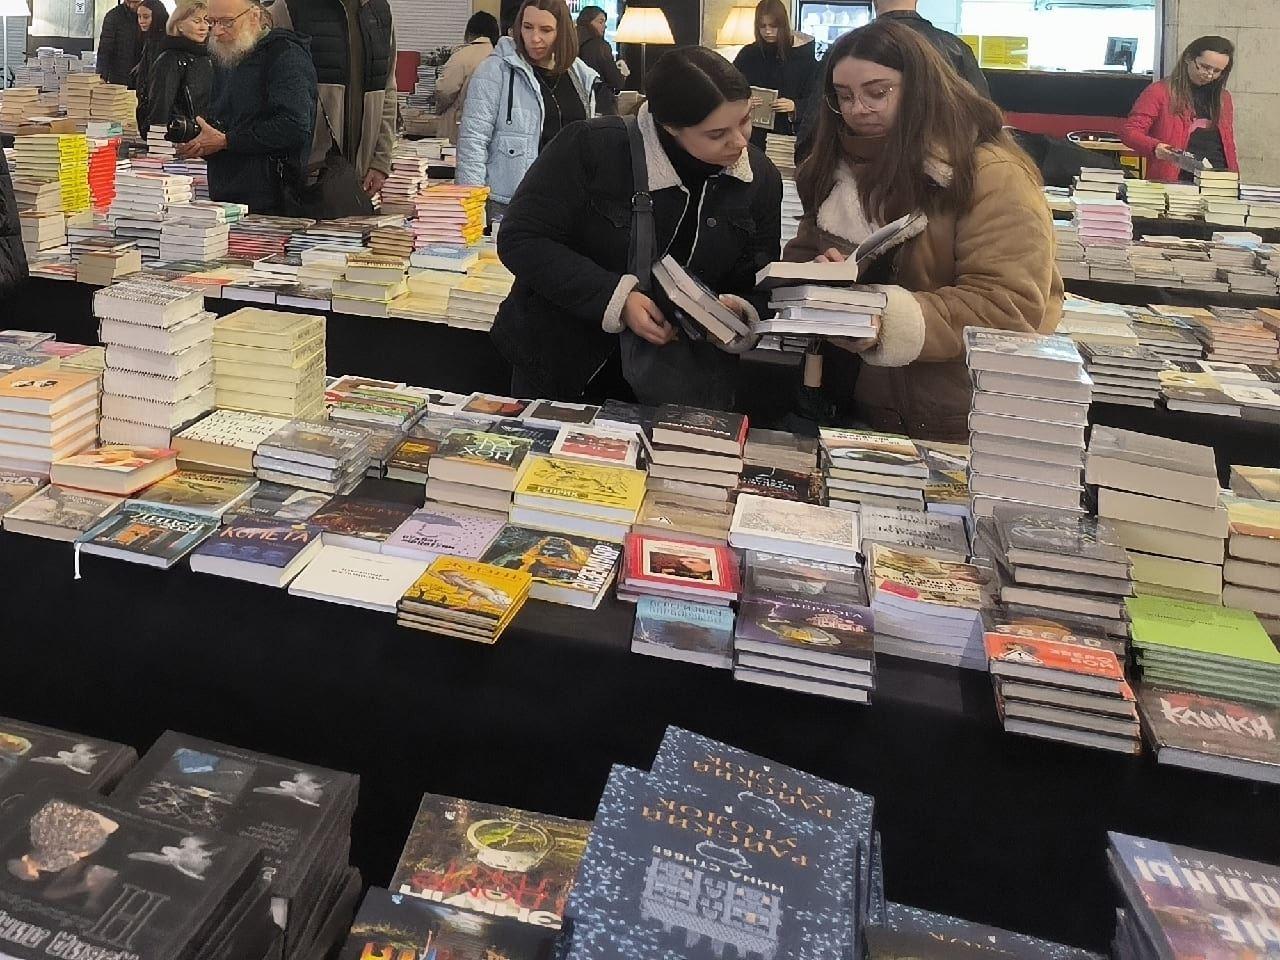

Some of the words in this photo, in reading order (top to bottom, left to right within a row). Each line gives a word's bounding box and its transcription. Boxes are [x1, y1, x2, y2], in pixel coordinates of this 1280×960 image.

[220, 523, 312, 544] КОМЕТА
[639, 806, 809, 867] РАЙСКИЙ
[657, 796, 798, 849] УГОЛОК
[728, 869, 785, 894] НИНА
[1132, 854, 1280, 908] ОЛНЫ
